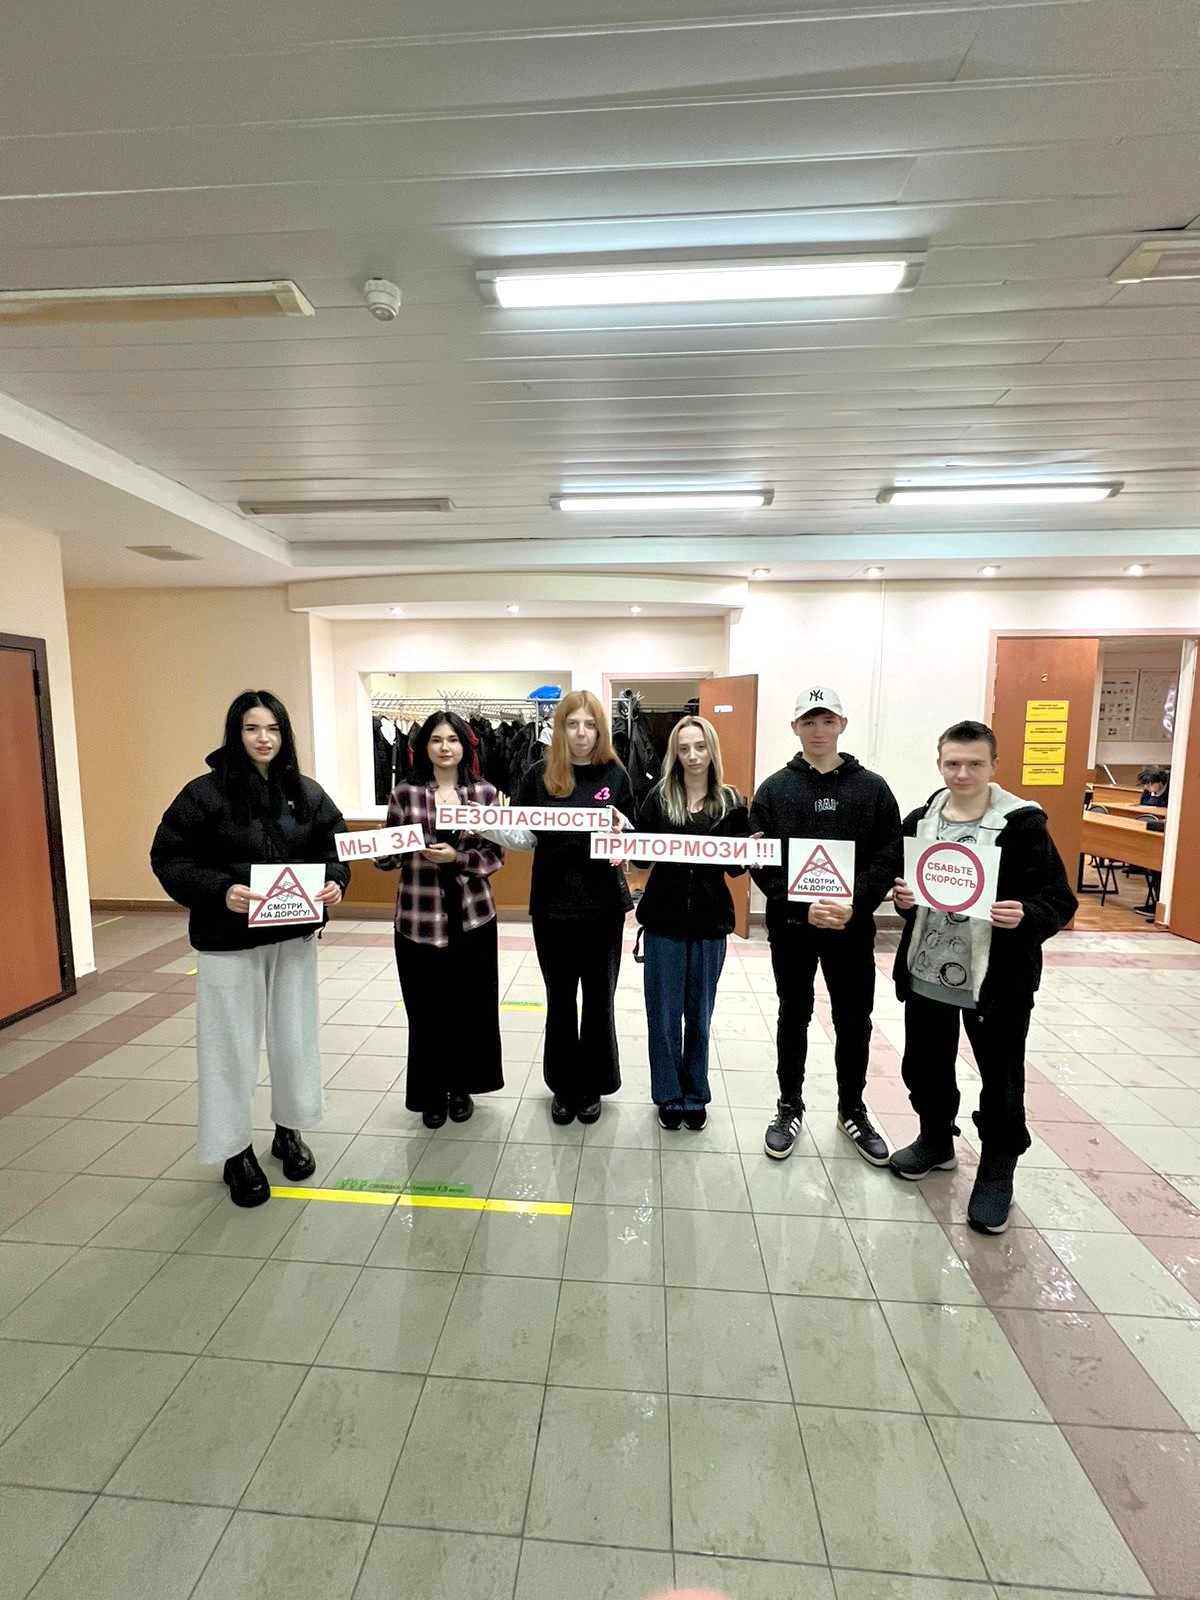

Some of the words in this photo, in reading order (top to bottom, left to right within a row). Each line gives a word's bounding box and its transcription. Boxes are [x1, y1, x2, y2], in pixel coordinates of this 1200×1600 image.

[1041, 673, 1047, 682] 2
[809, 689, 824, 701] NY
[438, 807, 611, 828] БЕЗОПАСНОСТЬ
[339, 839, 378, 857] МЫ
[390, 830, 422, 851] ЗА
[594, 838, 748, 859] ПРИТОРМОЗИ
[927, 861, 973, 876] СБАВЬТЕ
[803, 877, 835, 885] СМОТРИ
[924, 872, 977, 889] СКОРОСТЬ
[810, 885, 843, 893] ДОРОГУ!
[267, 902, 303, 911] СМОТРИ
[274, 909, 311, 919] ДОРОГУ!
